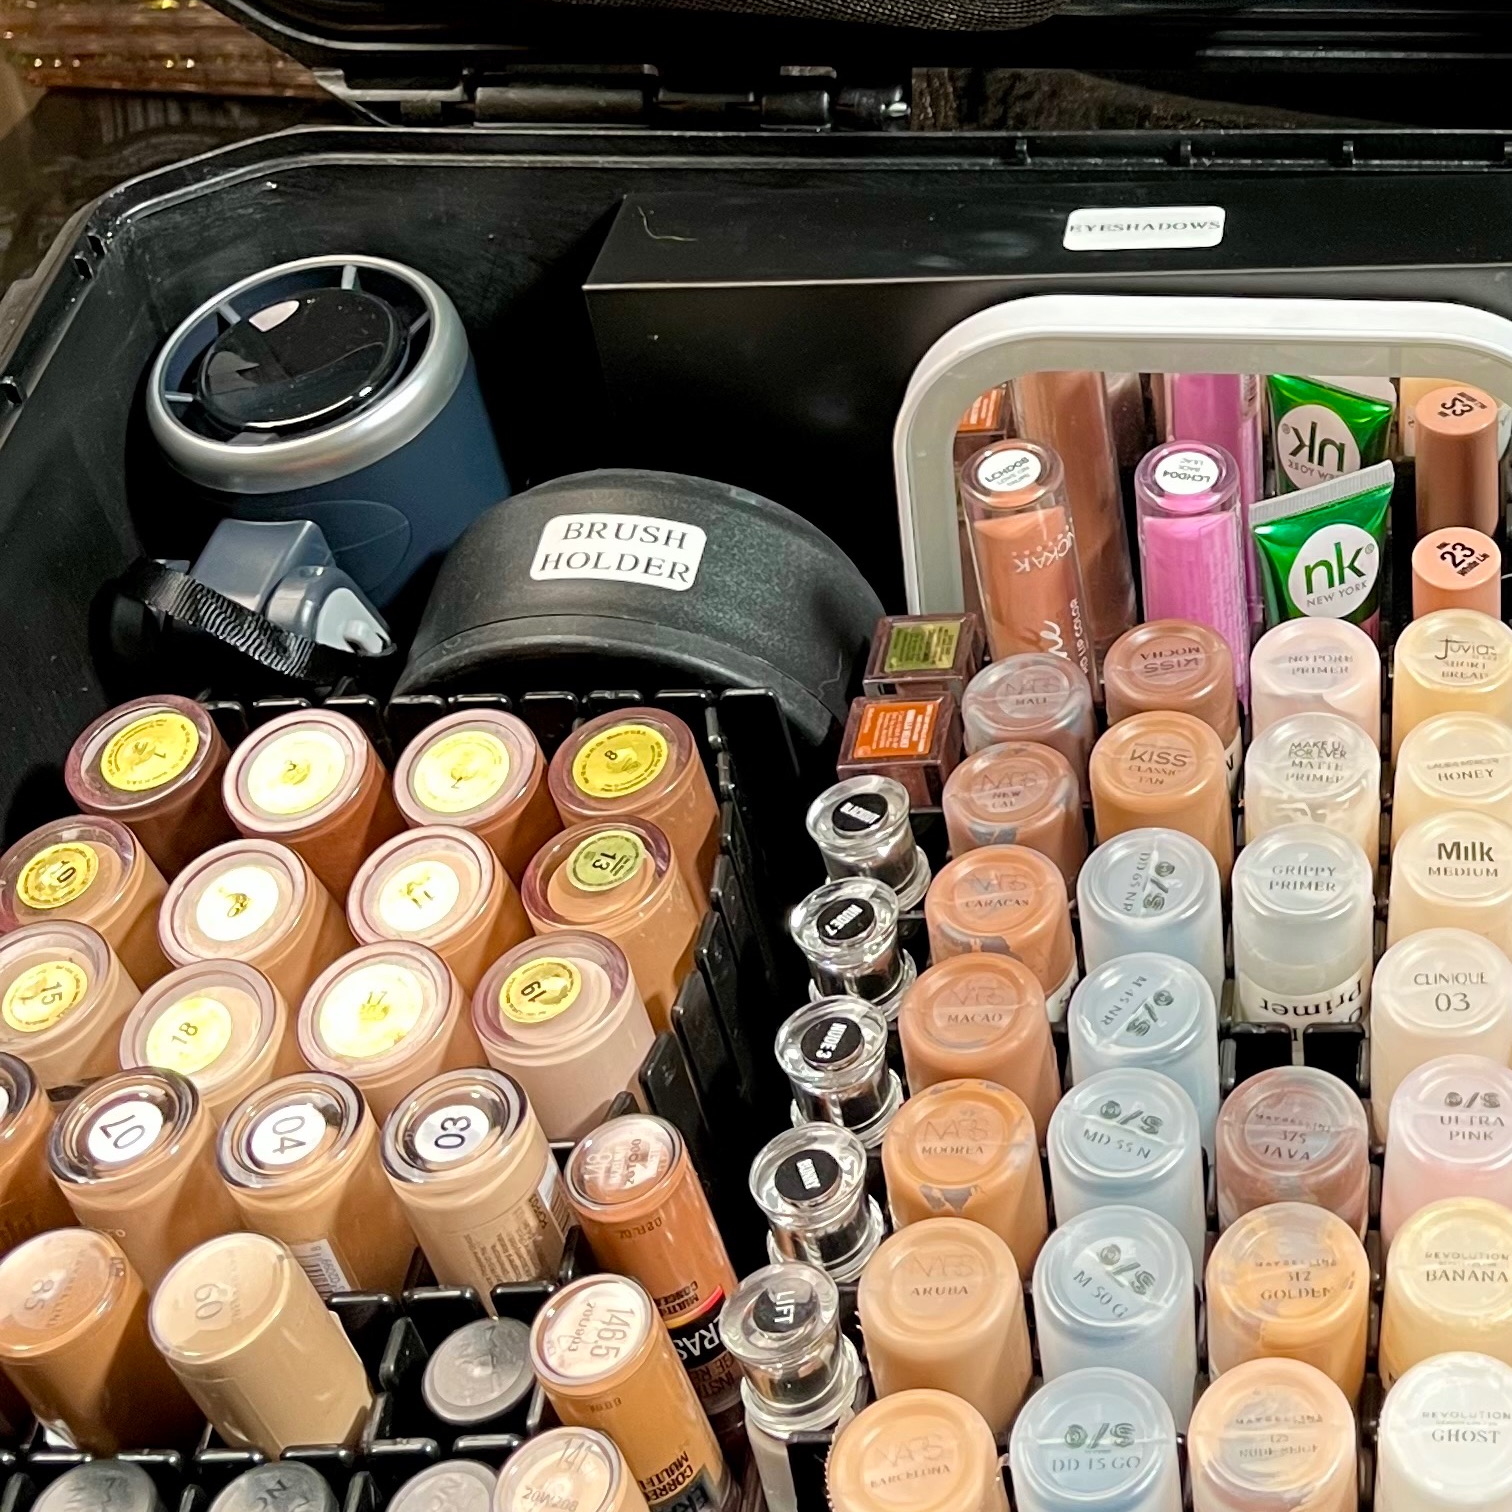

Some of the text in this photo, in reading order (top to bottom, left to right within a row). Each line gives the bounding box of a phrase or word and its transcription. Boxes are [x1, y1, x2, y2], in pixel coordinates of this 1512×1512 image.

[1070, 220, 1221, 232] EYESHADOWS
[561, 522, 688, 549] BRUSH
[1440, 542, 1475, 569] 23
[539, 551, 691, 583] HOLDER
[1304, 541, 1366, 595] nk
[1306, 580, 1368, 608] NEW YORK
[1140, 646, 1201, 660] MOCHA
[1288, 654, 1309, 664] NO
[1144, 656, 1201, 675] KISS
[1291, 665, 1351, 675] PRIMER
[1441, 670, 1489, 680] BREAD
[1290, 741, 1325, 751] MAKE
[1129, 748, 1192, 768] KISS
[1288, 748, 1348, 760] FOR EVER
[1128, 765, 1181, 777] CLASSIC
[1437, 769, 1495, 782] HONEY
[1138, 775, 1165, 786] TAN
[1437, 841, 1495, 863] Milk
[1271, 863, 1337, 877] GRIPPY
[1427, 866, 1499, 878] MEDIUM
[1269, 879, 1337, 893] PRIMER
[965, 898, 1030, 909] CARACAS
[1413, 972, 1489, 986] CLINIQUE
[1260, 978, 1362, 1017] primer
[1434, 992, 1471, 1013] 03
[947, 1013, 1004, 1024] MACAO
[815, 1021, 848, 1060] NUDE 3
[1440, 1115, 1505, 1128] ULTRA
[271, 1115, 307, 1155] 04
[434, 1115, 472, 1150] 03
[1449, 1130, 1494, 1141] PINK
[921, 1144, 984, 1155] MOOREA
[1137, 1145, 1152, 1160] N
[1263, 1145, 1311, 1161] JAVA
[1425, 1252, 1509, 1261] REVOLUTION
[1073, 1270, 1092, 1288] M
[1425, 1270, 1509, 1284] BANANA
[910, 1285, 970, 1297] ARUBA
[1260, 1288, 1332, 1301] GOLDEN
[773, 1290, 797, 1324] LIFT
[590, 1307, 636, 1359] 146.5
[1421, 1411, 1512, 1420] REVOLUTION
[1431, 1429, 1501, 1444] GHOST
[870, 1464, 951, 1488] BARCELONA
